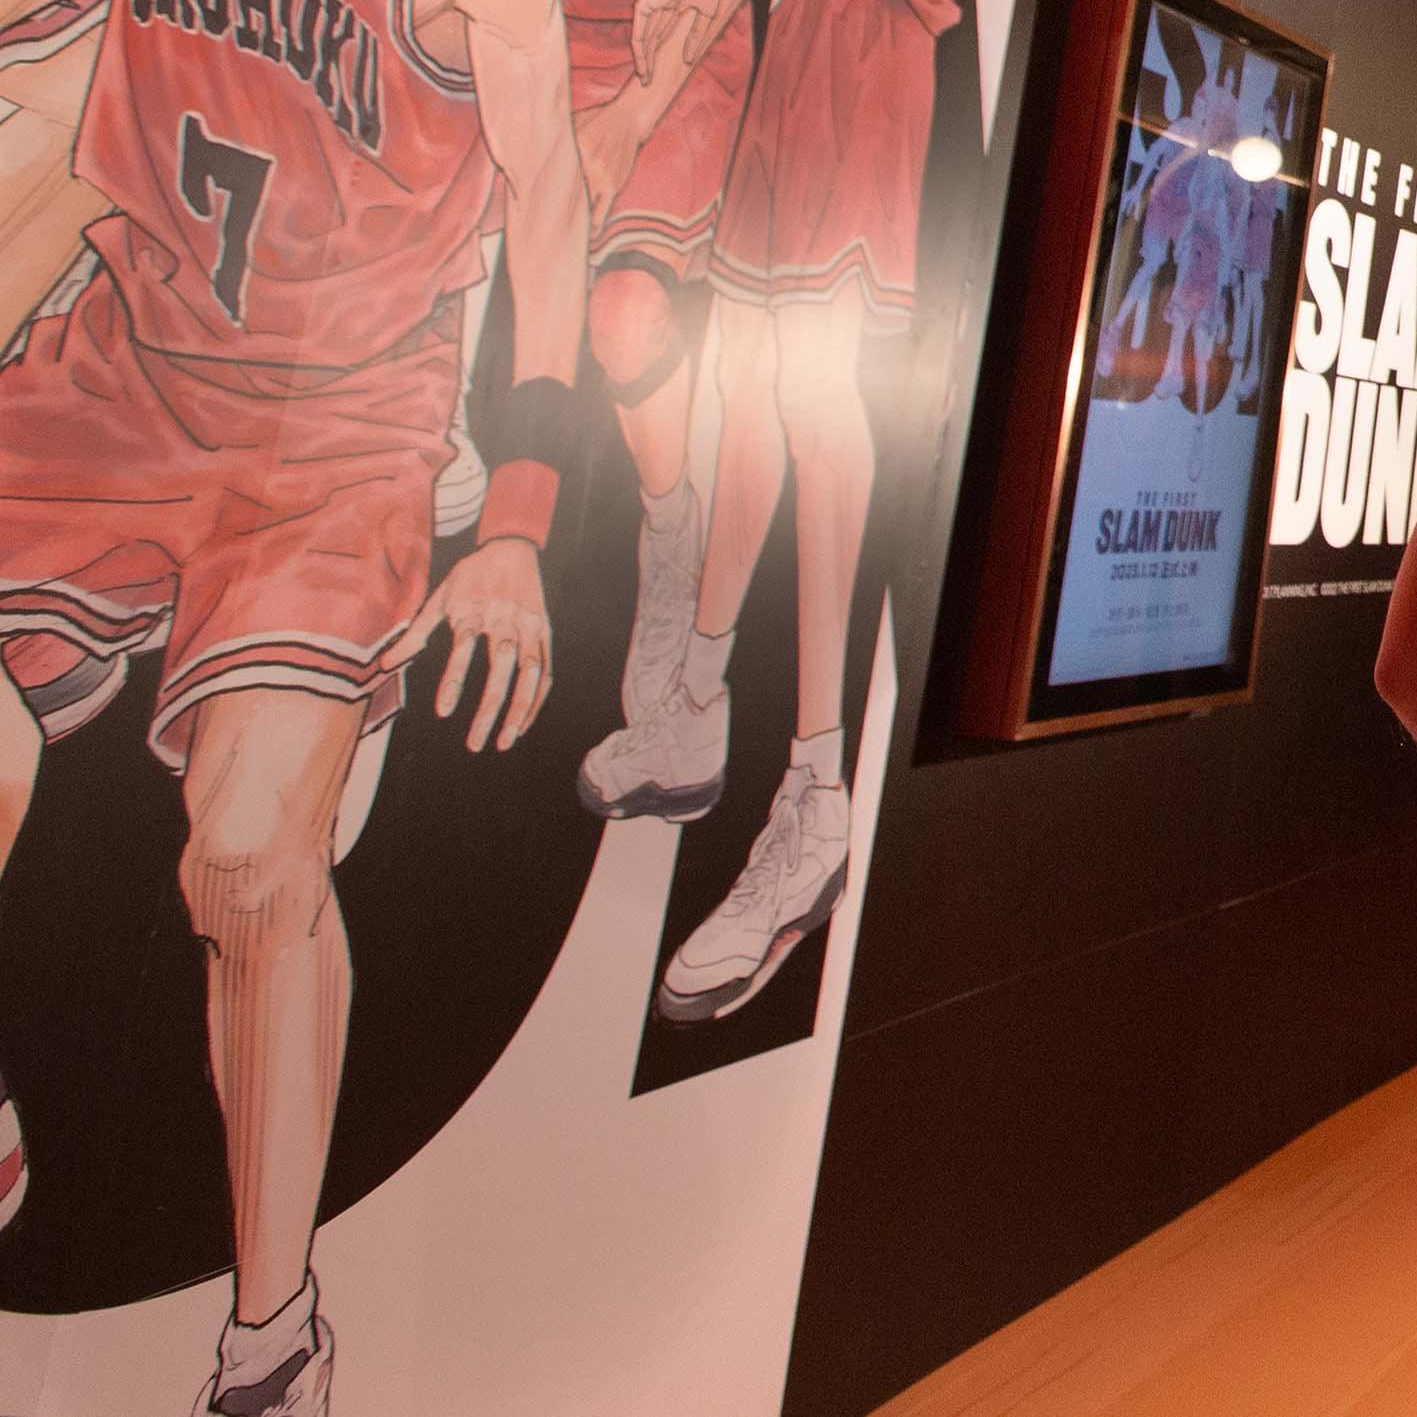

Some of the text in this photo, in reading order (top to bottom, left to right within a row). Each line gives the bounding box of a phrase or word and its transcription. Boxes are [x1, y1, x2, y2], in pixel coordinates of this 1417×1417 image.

[1317, 127, 1381, 207] THE
[177, 111, 276, 330] 7
[1095, 508, 1222, 555] SLAM DUNK
